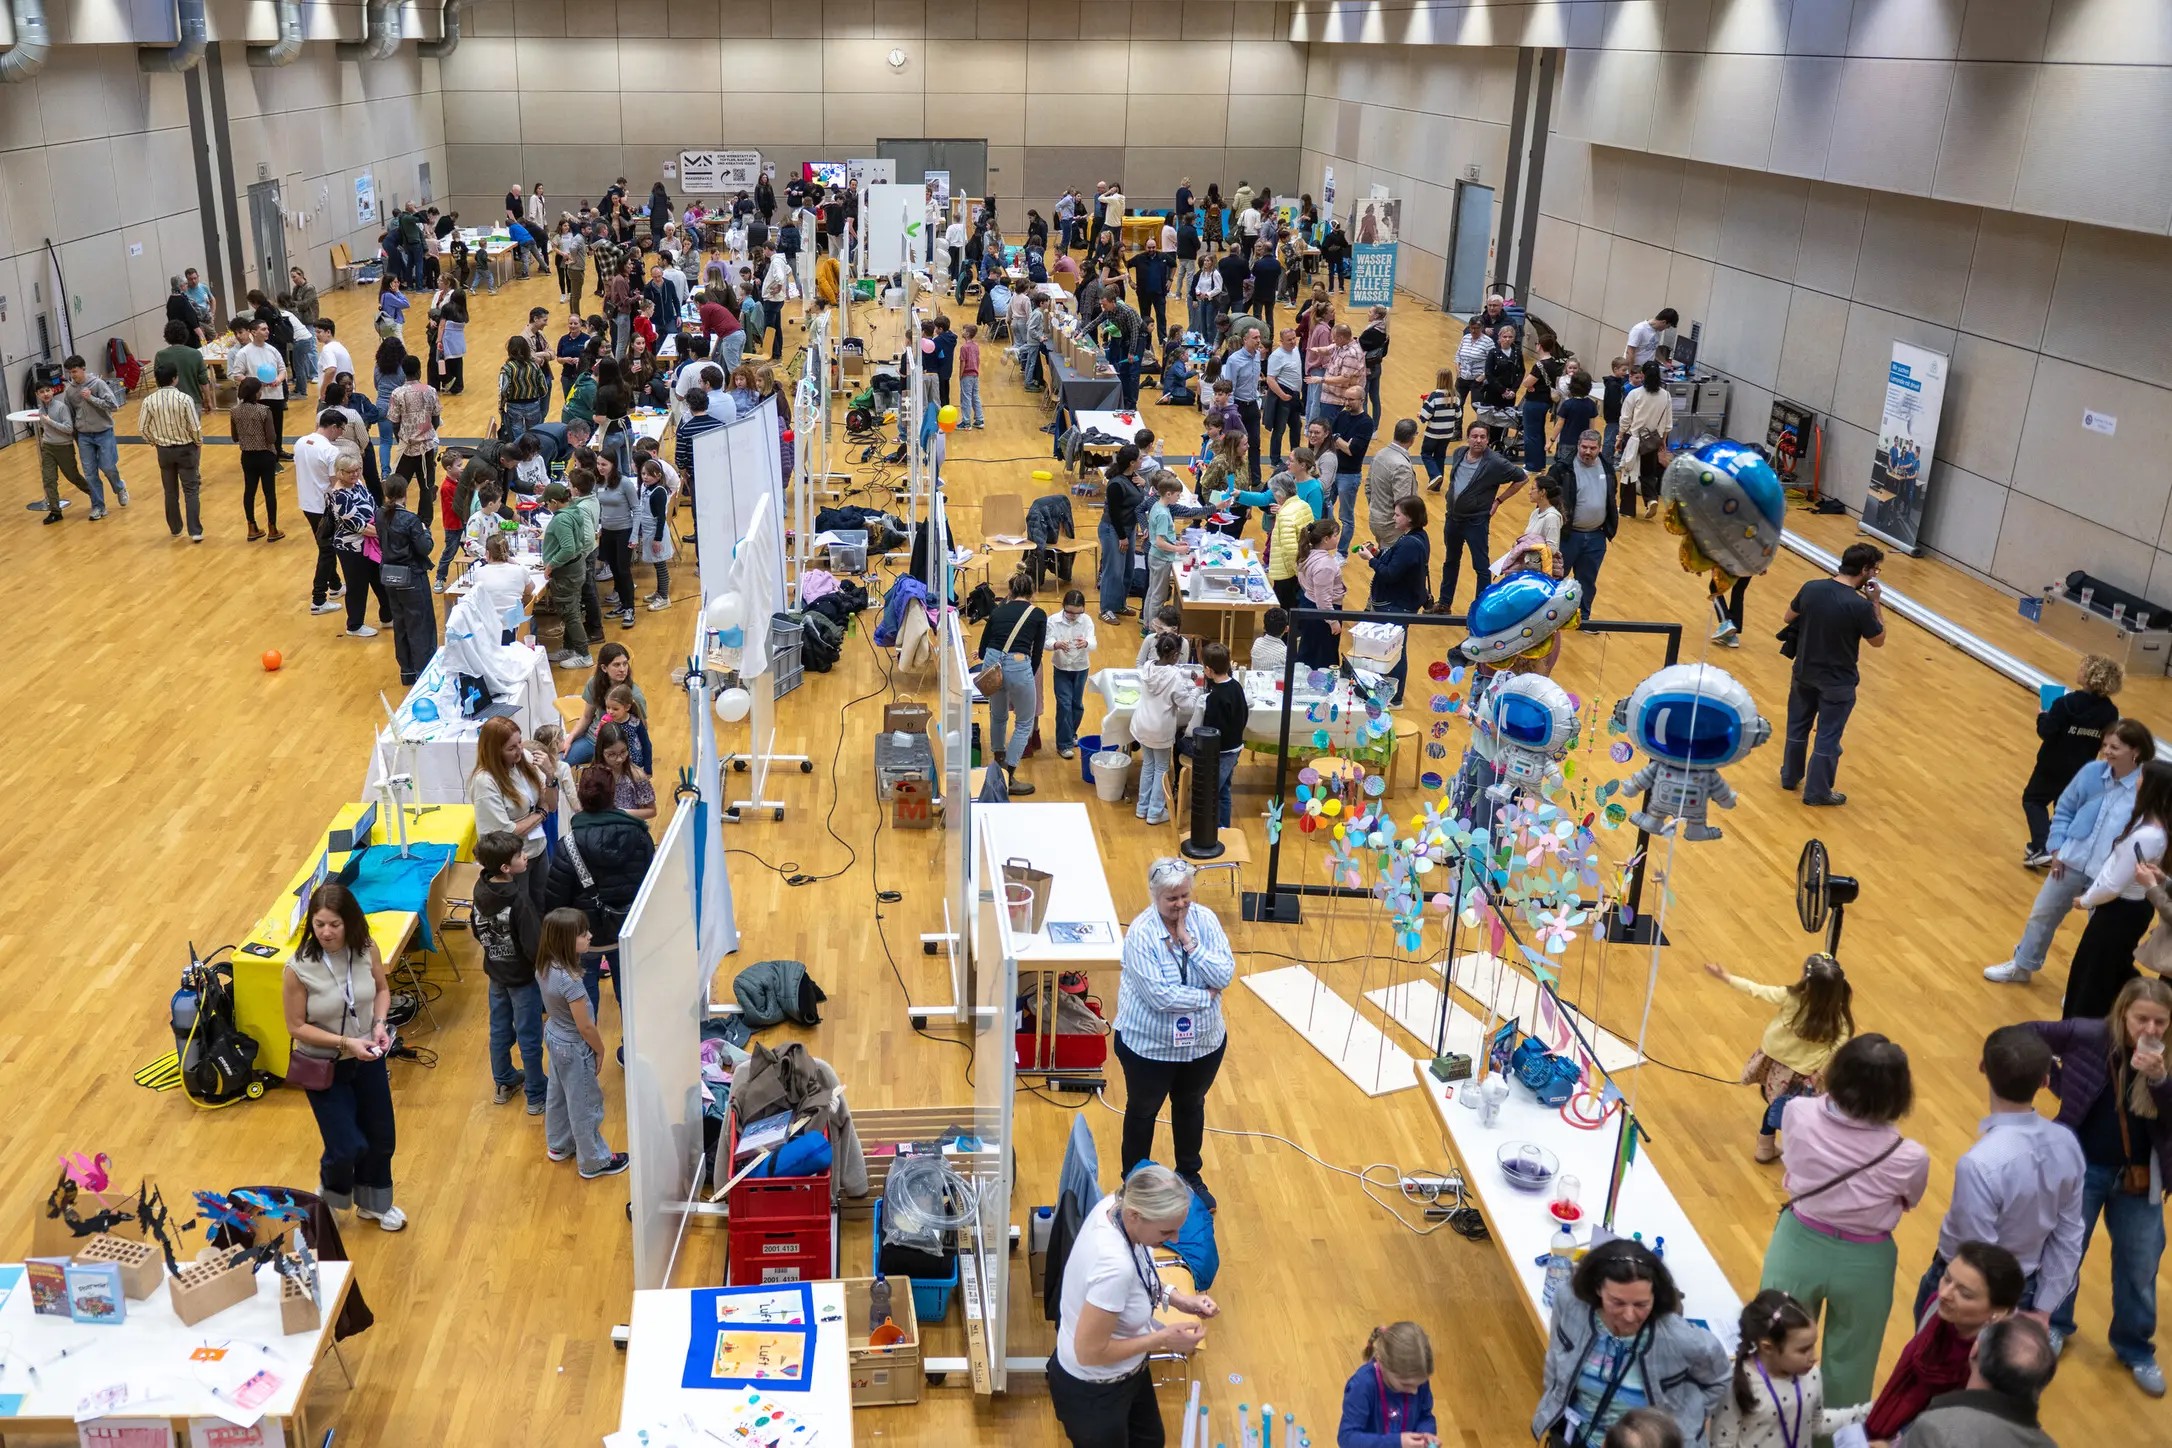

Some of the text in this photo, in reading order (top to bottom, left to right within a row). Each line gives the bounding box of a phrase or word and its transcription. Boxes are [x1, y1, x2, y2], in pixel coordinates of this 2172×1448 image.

[1356, 253, 1393, 265] WASSER
[1355, 264, 1392, 278] FÜR ALLE
[1354, 277, 1391, 291] ALLE FÜR
[1353, 290, 1390, 302] WASSER
[2067, 725, 2078, 735] JC
[897, 798, 927, 820] M
[759, 1303, 772, 1323] Luft
[758, 1345, 772, 1366] Luft
